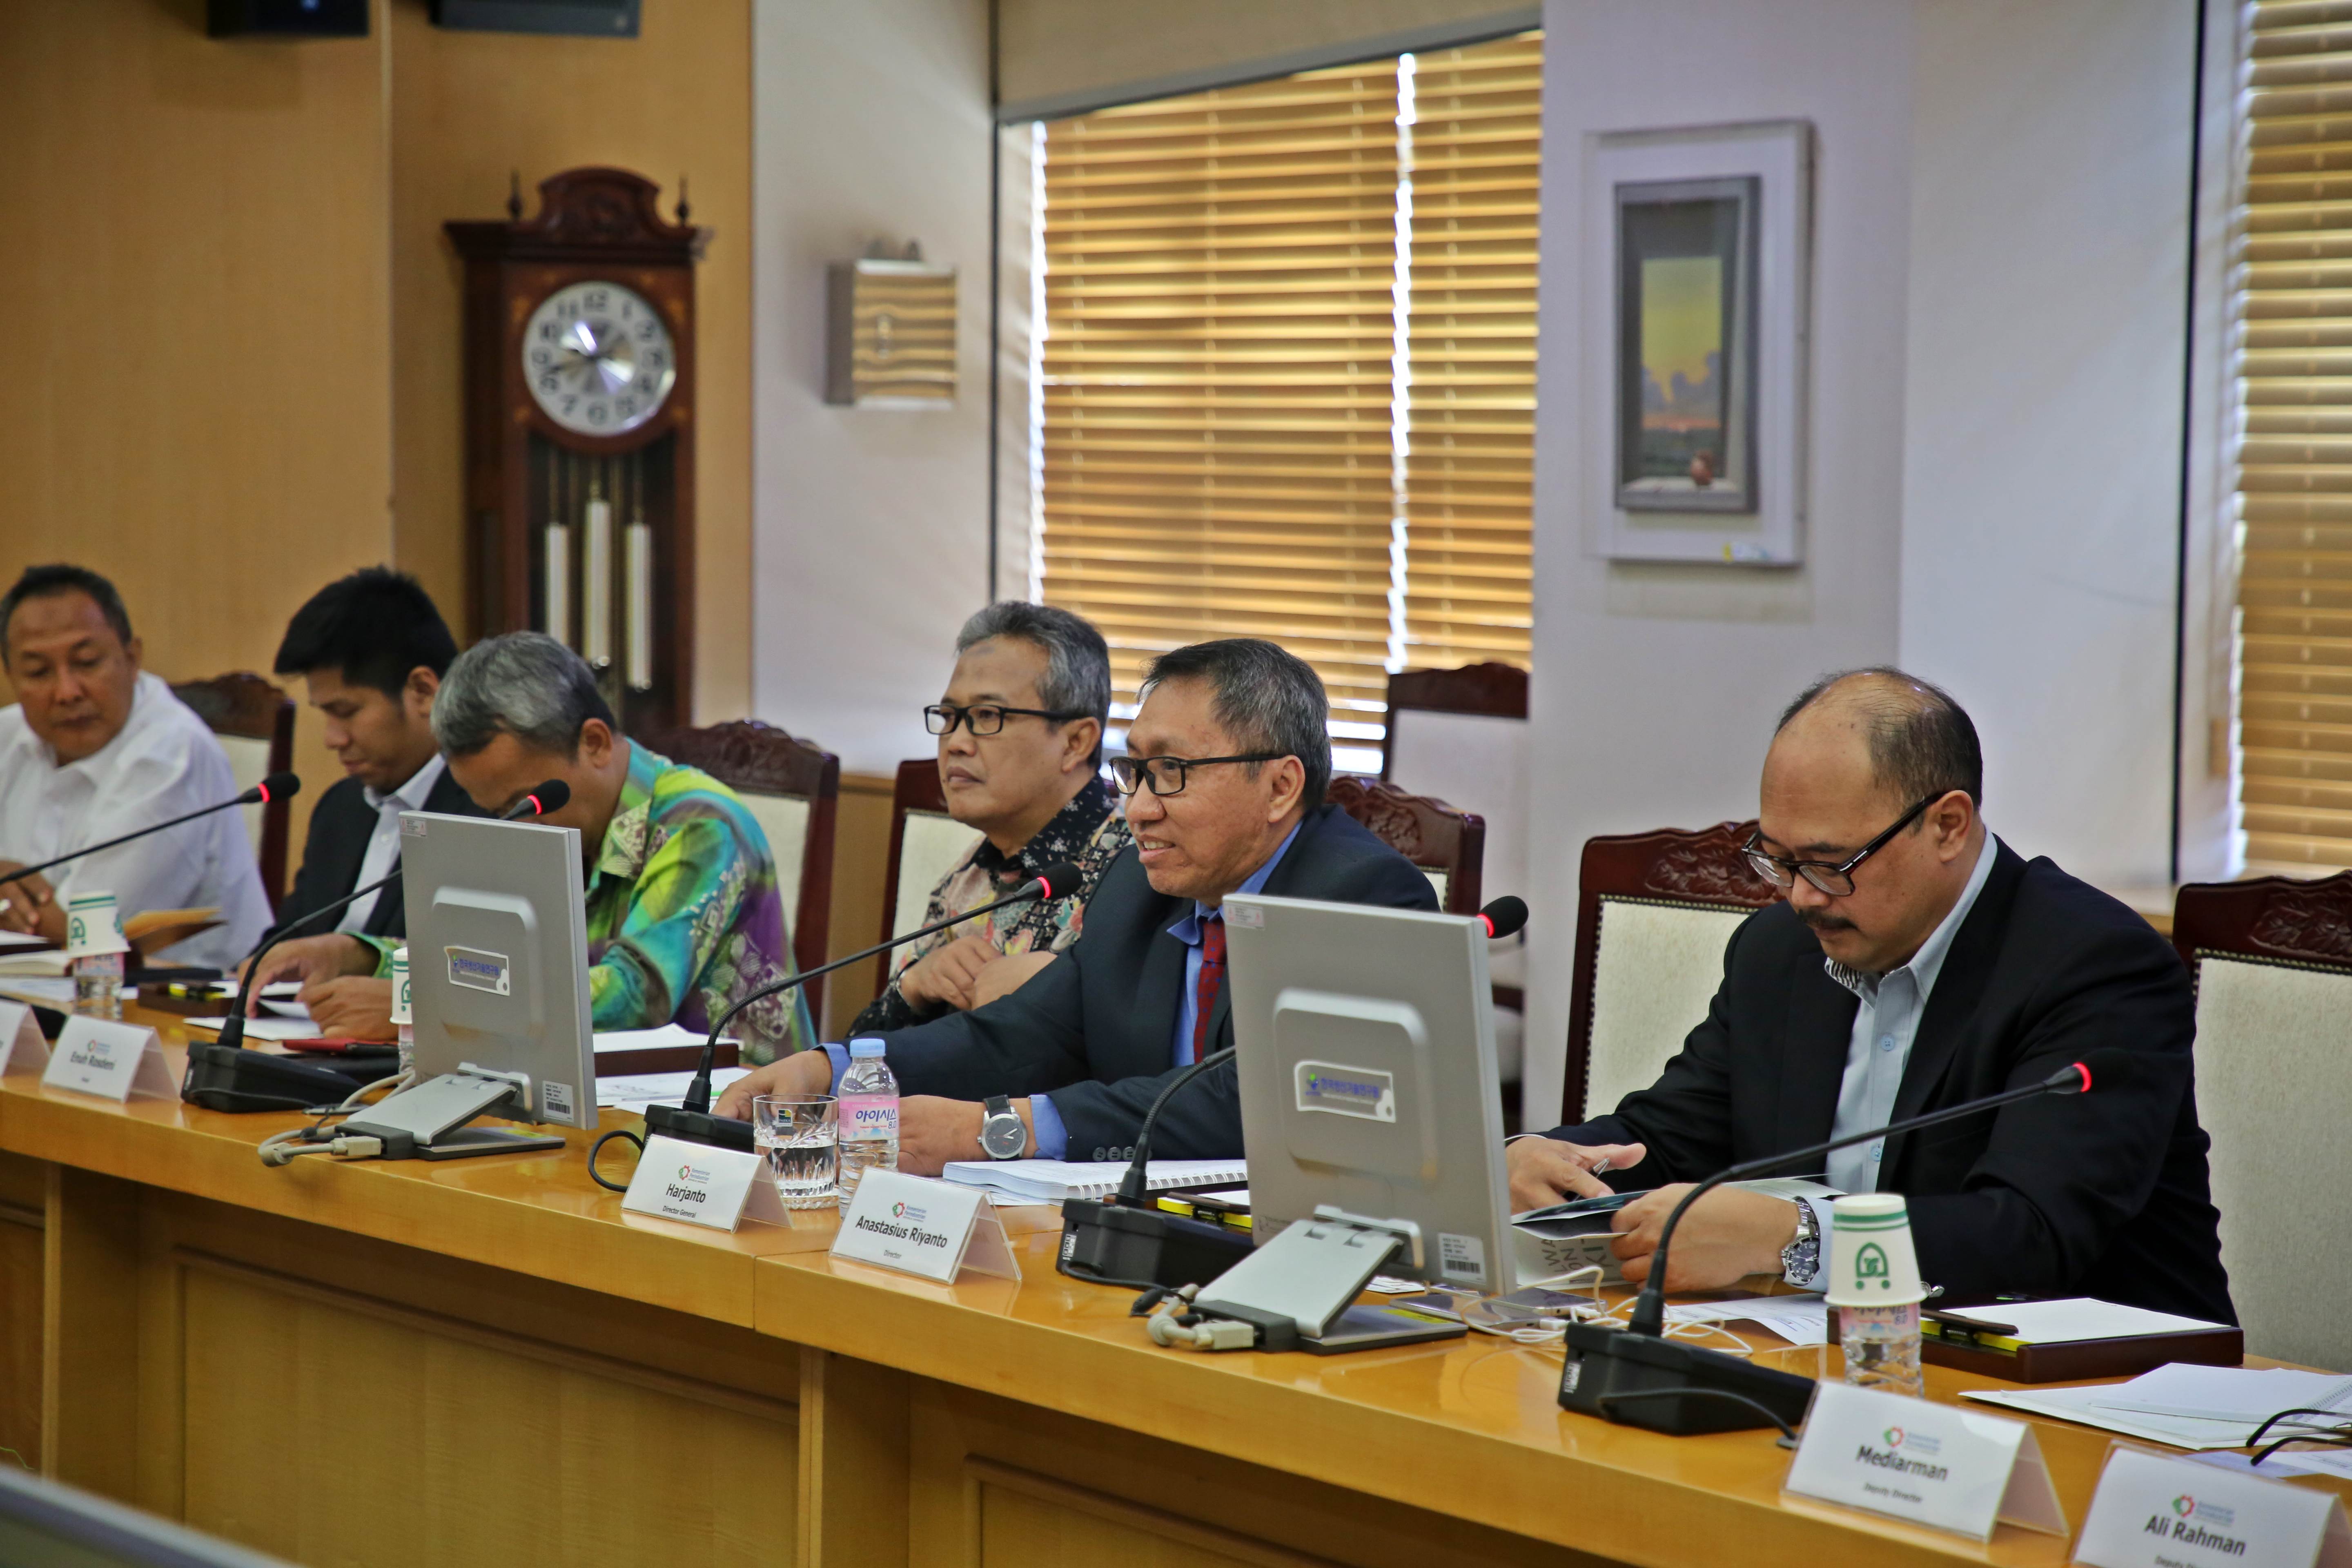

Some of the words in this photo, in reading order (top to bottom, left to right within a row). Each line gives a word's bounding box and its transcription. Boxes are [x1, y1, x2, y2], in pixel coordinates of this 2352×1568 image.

[856, 1109, 896, 1122] 아이시스
[888, 1121, 897, 1129] 8.0
[666, 1183, 706, 1204] Harjanto
[662, 1205, 679, 1216] Director
[680, 1208, 697, 1219] General
[855, 1216, 907, 1239] Anastasius
[909, 1227, 948, 1249] Riyanto
[884, 1250, 902, 1259] Director
[1856, 1445, 1949, 1481] Mediarman
[2145, 1515, 2169, 1536] Ali
[2172, 1521, 2247, 1556] Rahman
